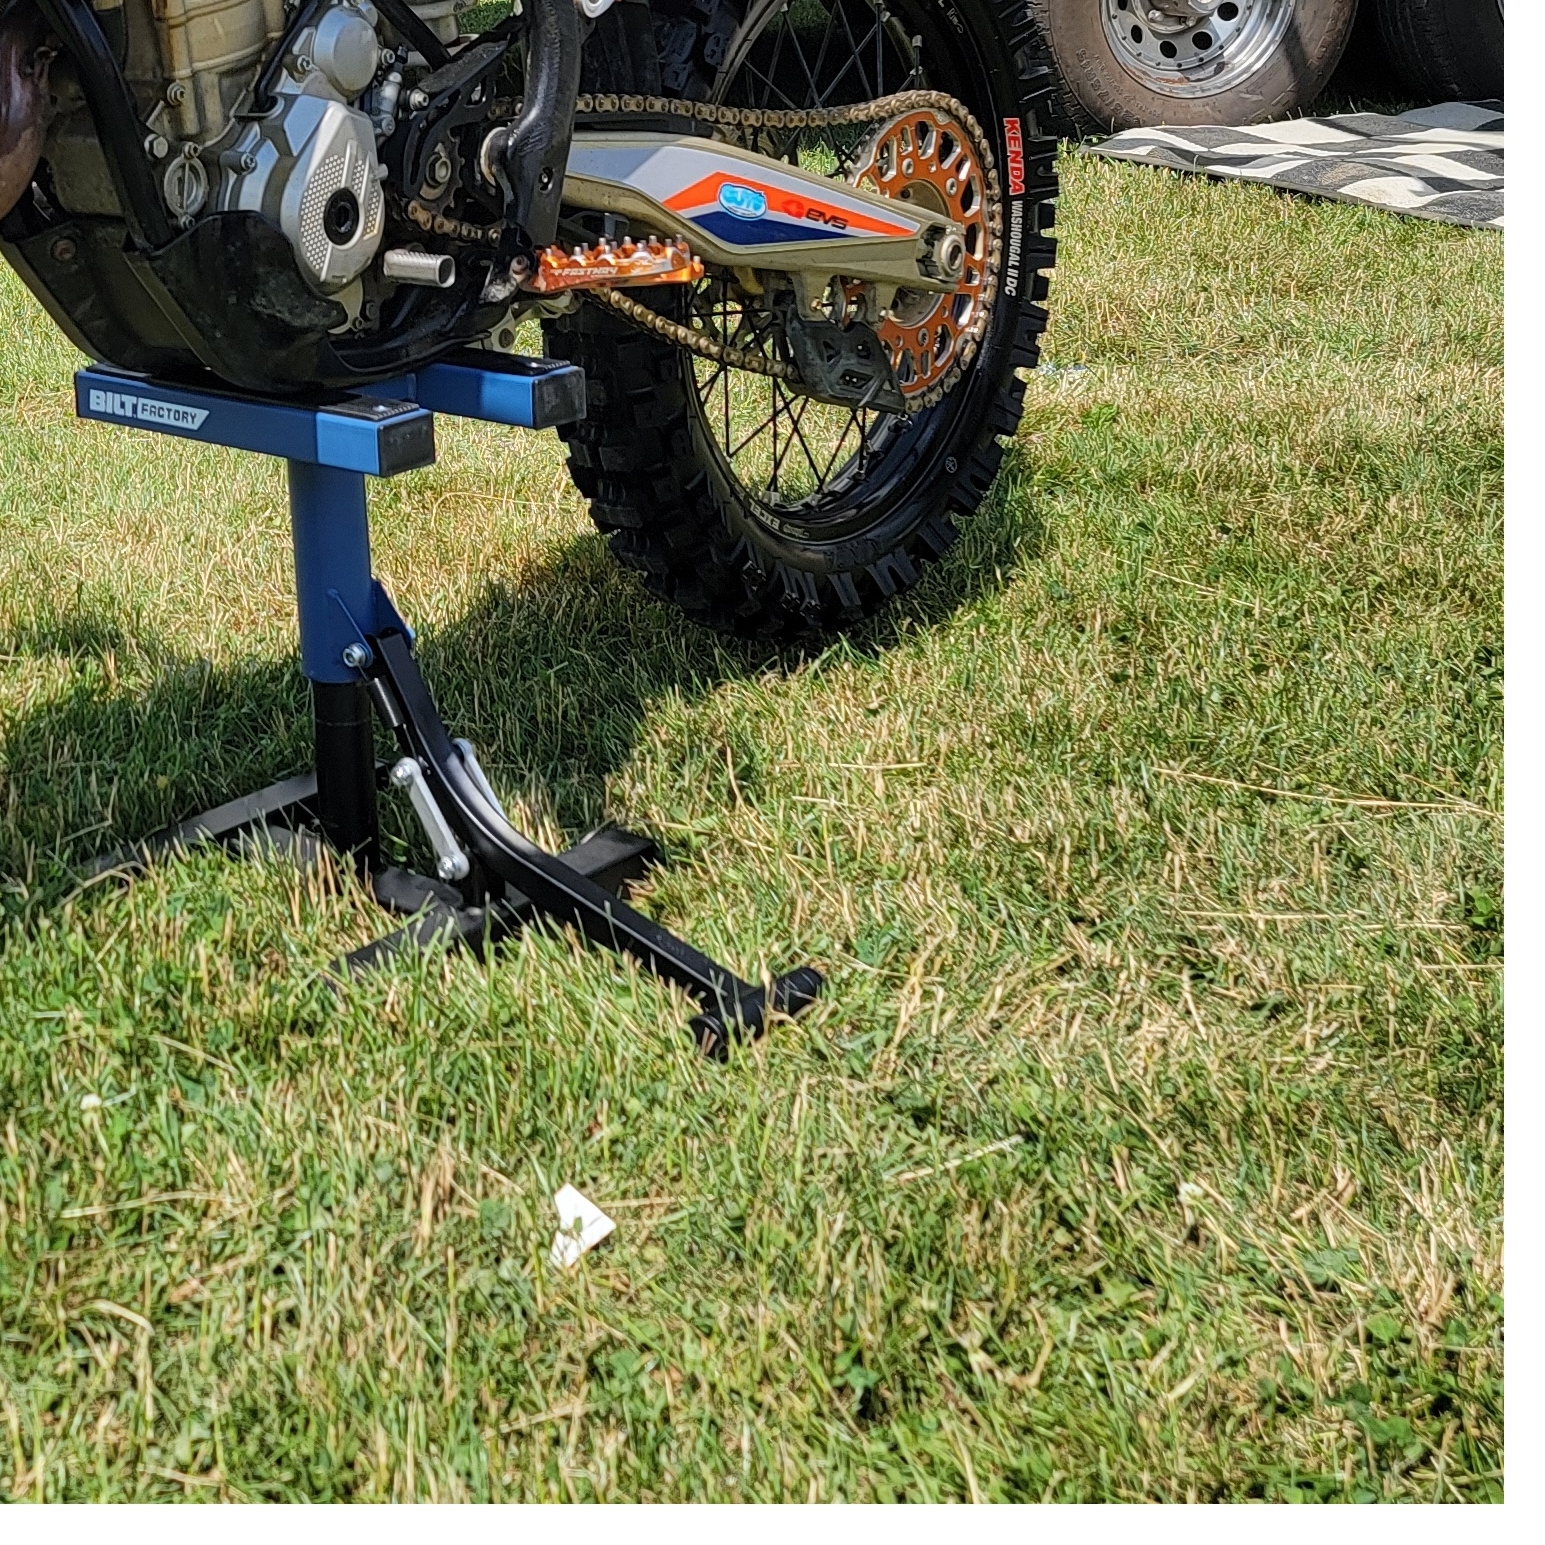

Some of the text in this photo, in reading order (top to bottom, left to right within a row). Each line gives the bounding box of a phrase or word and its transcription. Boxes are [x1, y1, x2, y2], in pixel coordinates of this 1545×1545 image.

[1003, 117, 1025, 195] KENDA
[1008, 200, 1023, 267] WASHOUGAL
[1004, 279, 1018, 297] DC
[89, 389, 197, 425] BILT FACTORY
